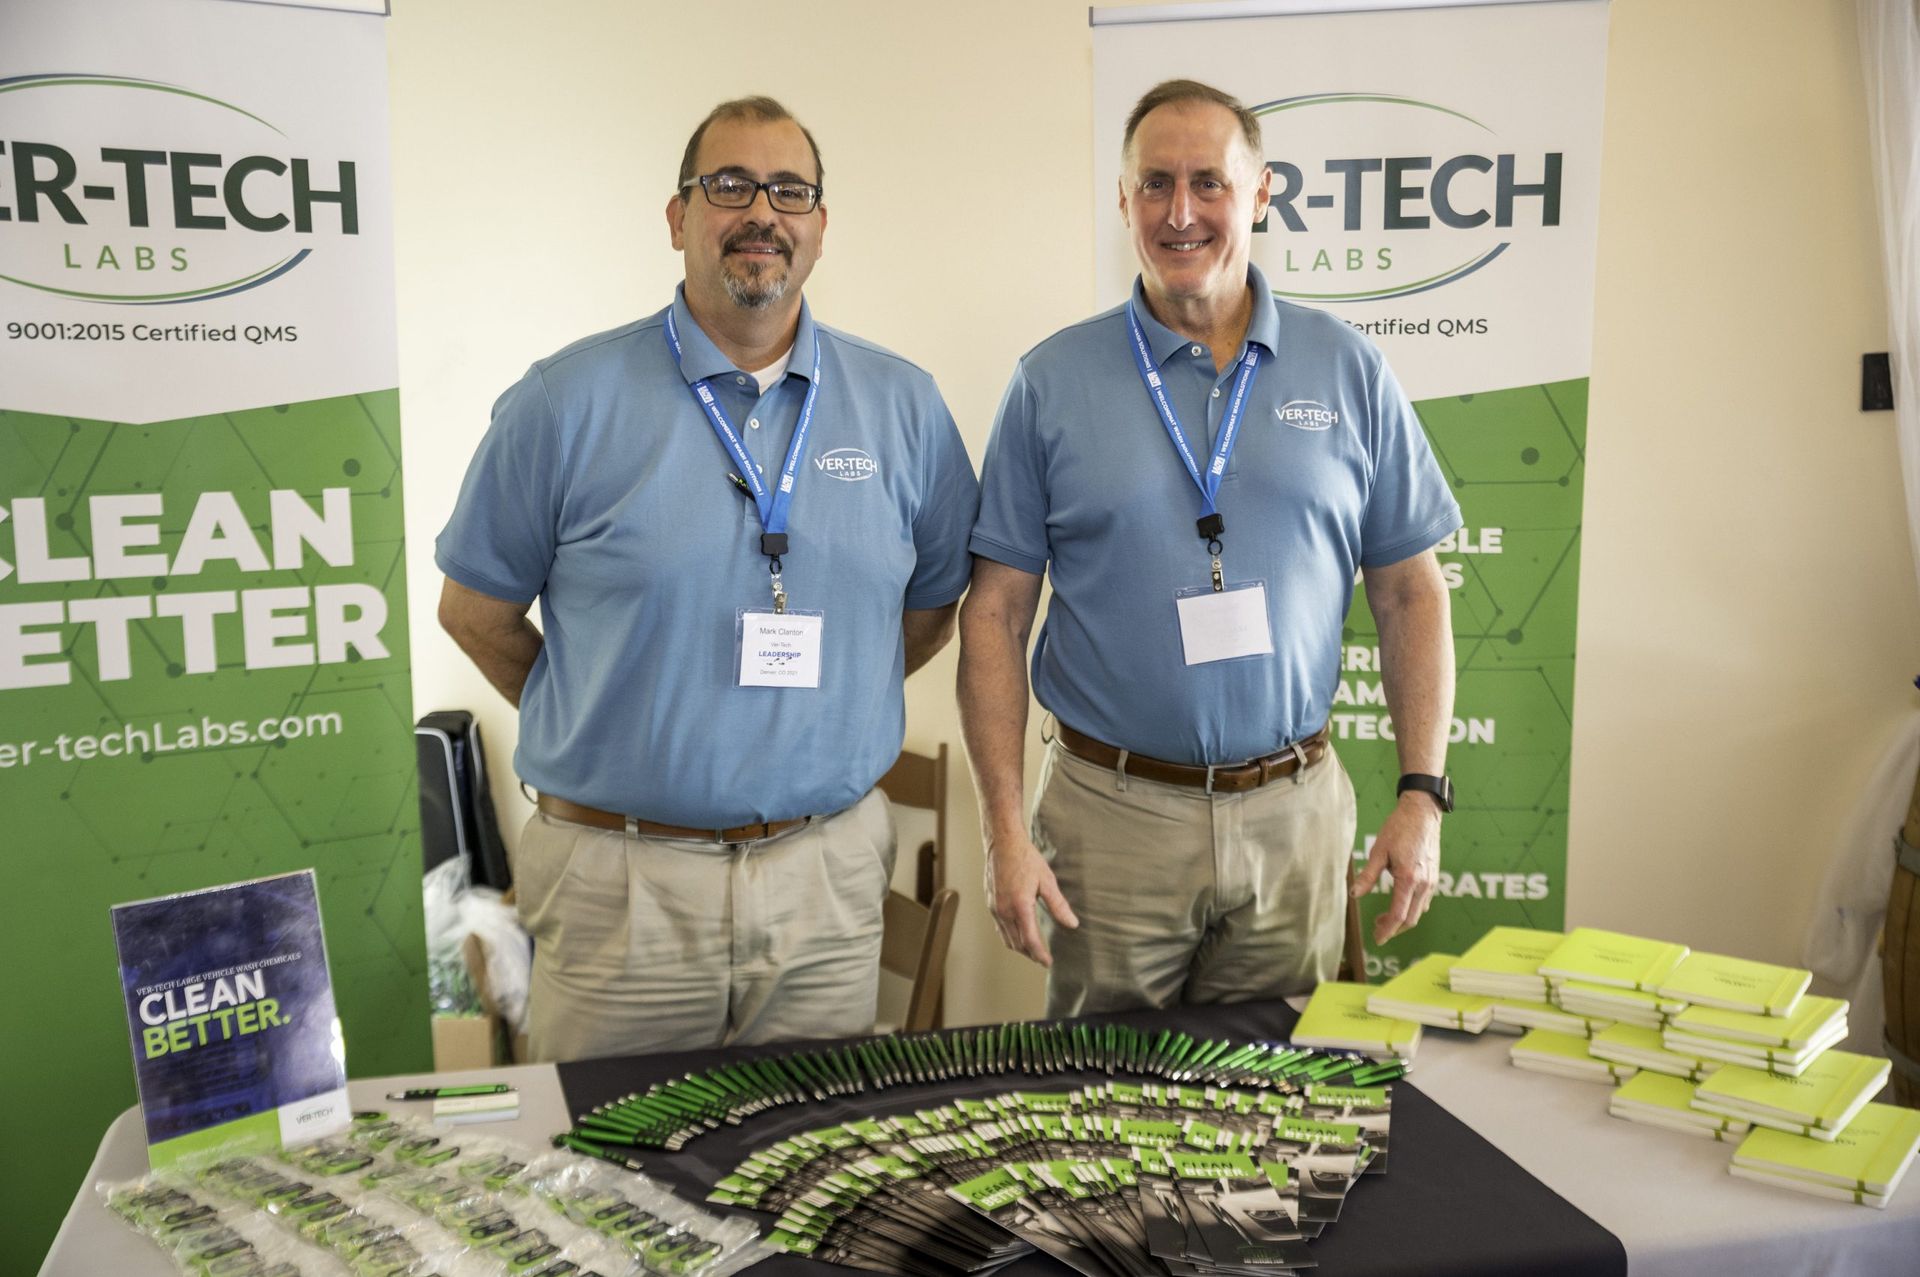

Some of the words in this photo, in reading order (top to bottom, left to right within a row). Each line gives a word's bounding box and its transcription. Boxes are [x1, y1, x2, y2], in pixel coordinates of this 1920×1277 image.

[0, 140, 359, 235] R-TECH
[64, 243, 188, 271] LABS
[1285, 247, 1393, 272] LABS
[7, 322, 125, 341] 9001:2015
[132, 323, 237, 342] Certified
[244, 325, 298, 344] QMS
[1344, 318, 1430, 335] ertified
[1437, 318, 1488, 337] QMS
[1232, 397, 1241, 414] WASH
[1238, 369, 1250, 397] SOLUTIONS
[1275, 408, 1338, 424] VER-TECH
[1173, 425, 1184, 443] WASH
[734, 442, 747, 460] WASH
[744, 459, 762, 492] SOLUTIONS
[815, 457, 878, 473] VER-TECH
[0, 487, 354, 584] LEAN
[0, 583, 391, 690] ETTER
[760, 627, 777, 635] Mark
[778, 628, 804, 636] Clanton
[136, 982, 175, 997] VER-TECH
[176, 975, 201, 989] LARGE
[202, 968, 235, 981] VEHICLE
[235, 962, 258, 975] WASH
[259, 952, 302, 970] CHEMICALS
[139, 970, 266, 1026] CLEAN
[142, 997, 291, 1060] BETTER.
[296, 1108, 334, 1125] VER-TECH
